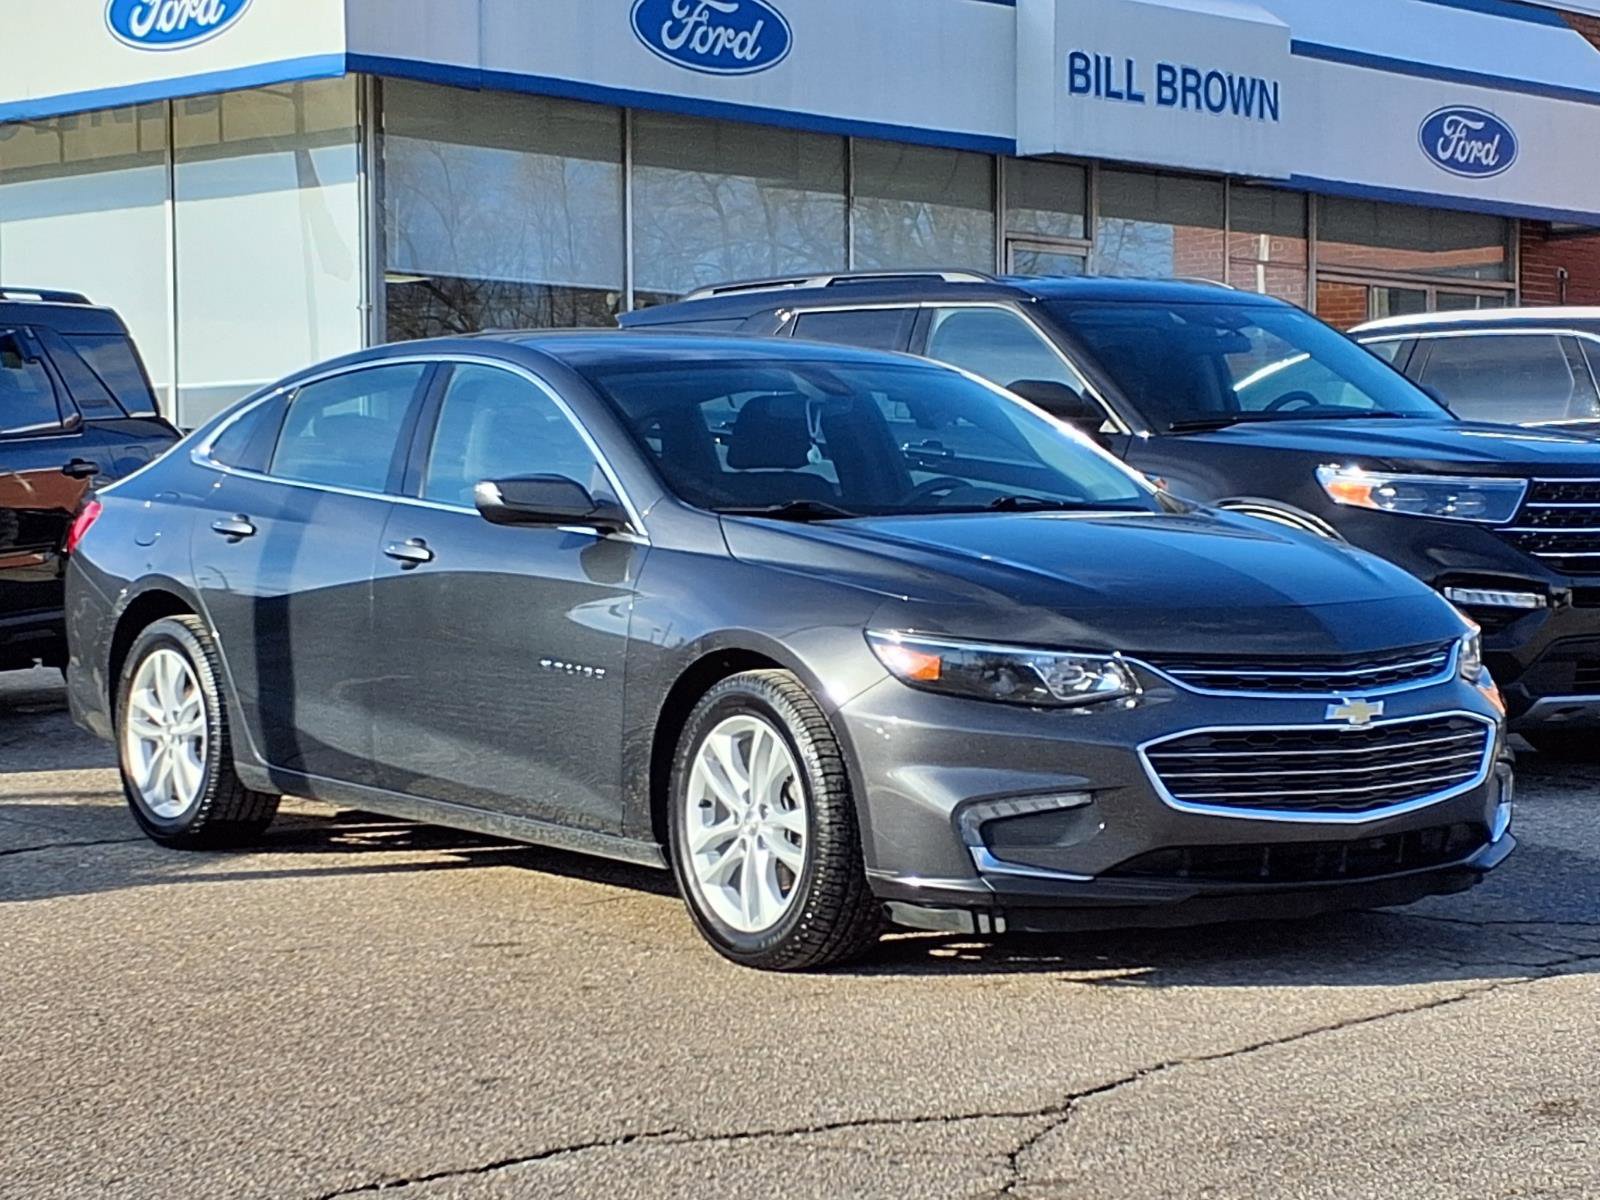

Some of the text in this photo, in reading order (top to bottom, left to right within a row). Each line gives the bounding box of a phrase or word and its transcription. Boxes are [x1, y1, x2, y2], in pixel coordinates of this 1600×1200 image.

[661, 0, 764, 61] Ford
[1068, 51, 1279, 122] BILL BROWN
[1437, 115, 1500, 166] Ford
